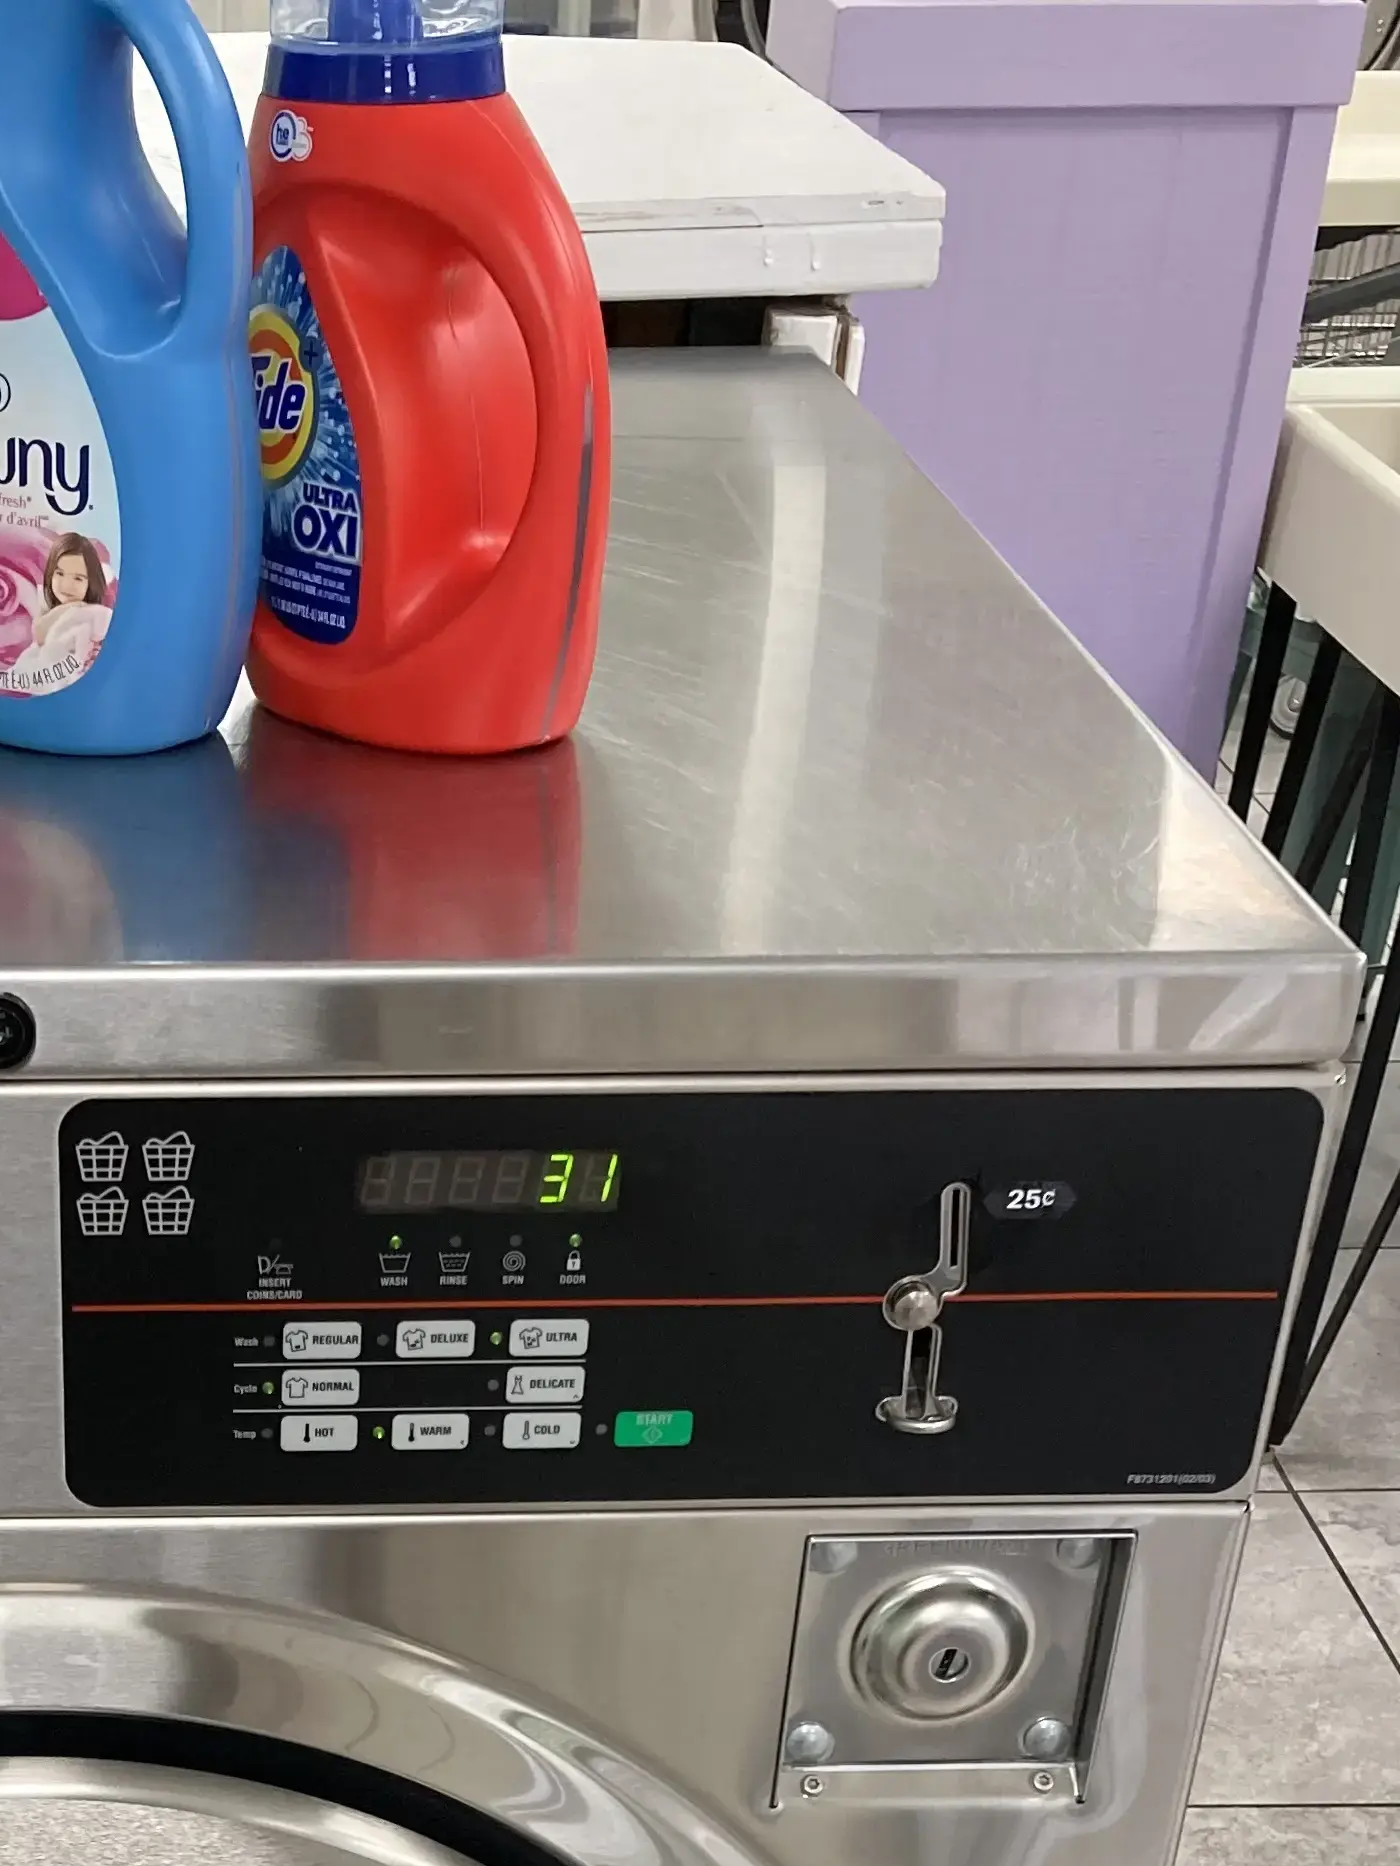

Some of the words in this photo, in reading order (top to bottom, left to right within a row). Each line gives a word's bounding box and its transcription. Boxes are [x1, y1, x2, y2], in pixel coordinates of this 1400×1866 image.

[302, 482, 358, 514] ULTRA
[293, 503, 358, 558] OXI
[540, 1153, 619, 1203] 31
[1006, 1187, 1057, 1210] 25¢
[258, 1277, 292, 1288] INSERT
[380, 1276, 408, 1287] WASH
[439, 1275, 468, 1286] RINSE
[502, 1275, 525, 1285] SPIN
[559, 1274, 586, 1285] DOOR
[233, 1336, 259, 1347] Wash
[312, 1334, 359, 1346] REGULAR
[430, 1333, 469, 1344] DELUXE
[545, 1332, 577, 1342] ULTRA
[312, 1381, 355, 1392] NORMAL
[529, 1378, 576, 1389] DELICATE
[233, 1384, 258, 1395] Cycle
[636, 1413, 673, 1425] START
[232, 1429, 257, 1440] Temp
[314, 1427, 335, 1437] HOT
[420, 1425, 452, 1436] WARM
[534, 1424, 561, 1435] COLD
